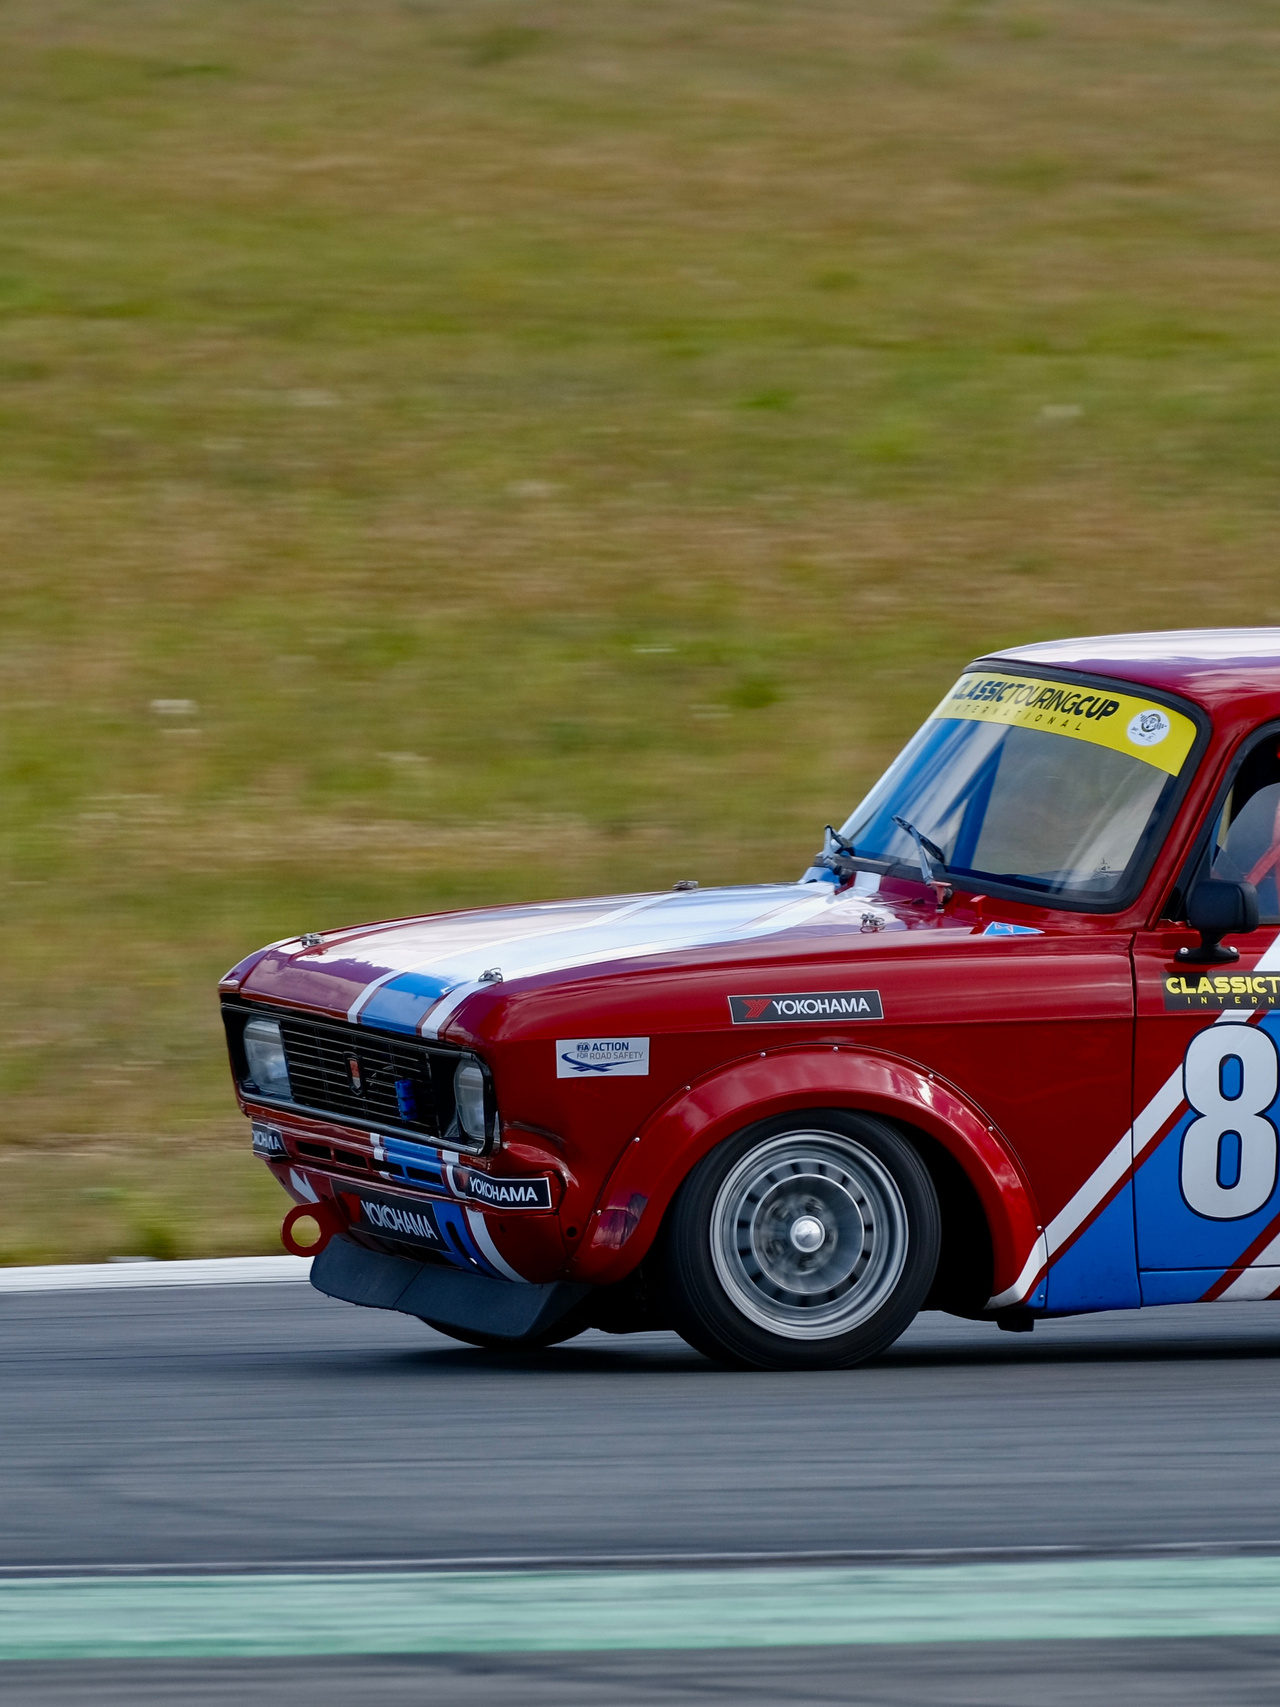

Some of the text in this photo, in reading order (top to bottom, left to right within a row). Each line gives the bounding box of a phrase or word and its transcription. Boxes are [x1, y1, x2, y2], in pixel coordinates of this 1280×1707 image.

[952, 680, 1120, 721] LASSICTOURINGCUP
[771, 997, 871, 1015] YOKOHAMA
[589, 1052, 612, 1060] ROAD
[613, 1051, 644, 1060] SAFETY
[591, 1042, 630, 1052] ACTION
[469, 1176, 539, 1202] YOKOHAMA
[360, 1199, 439, 1241] YOKOHAMA
